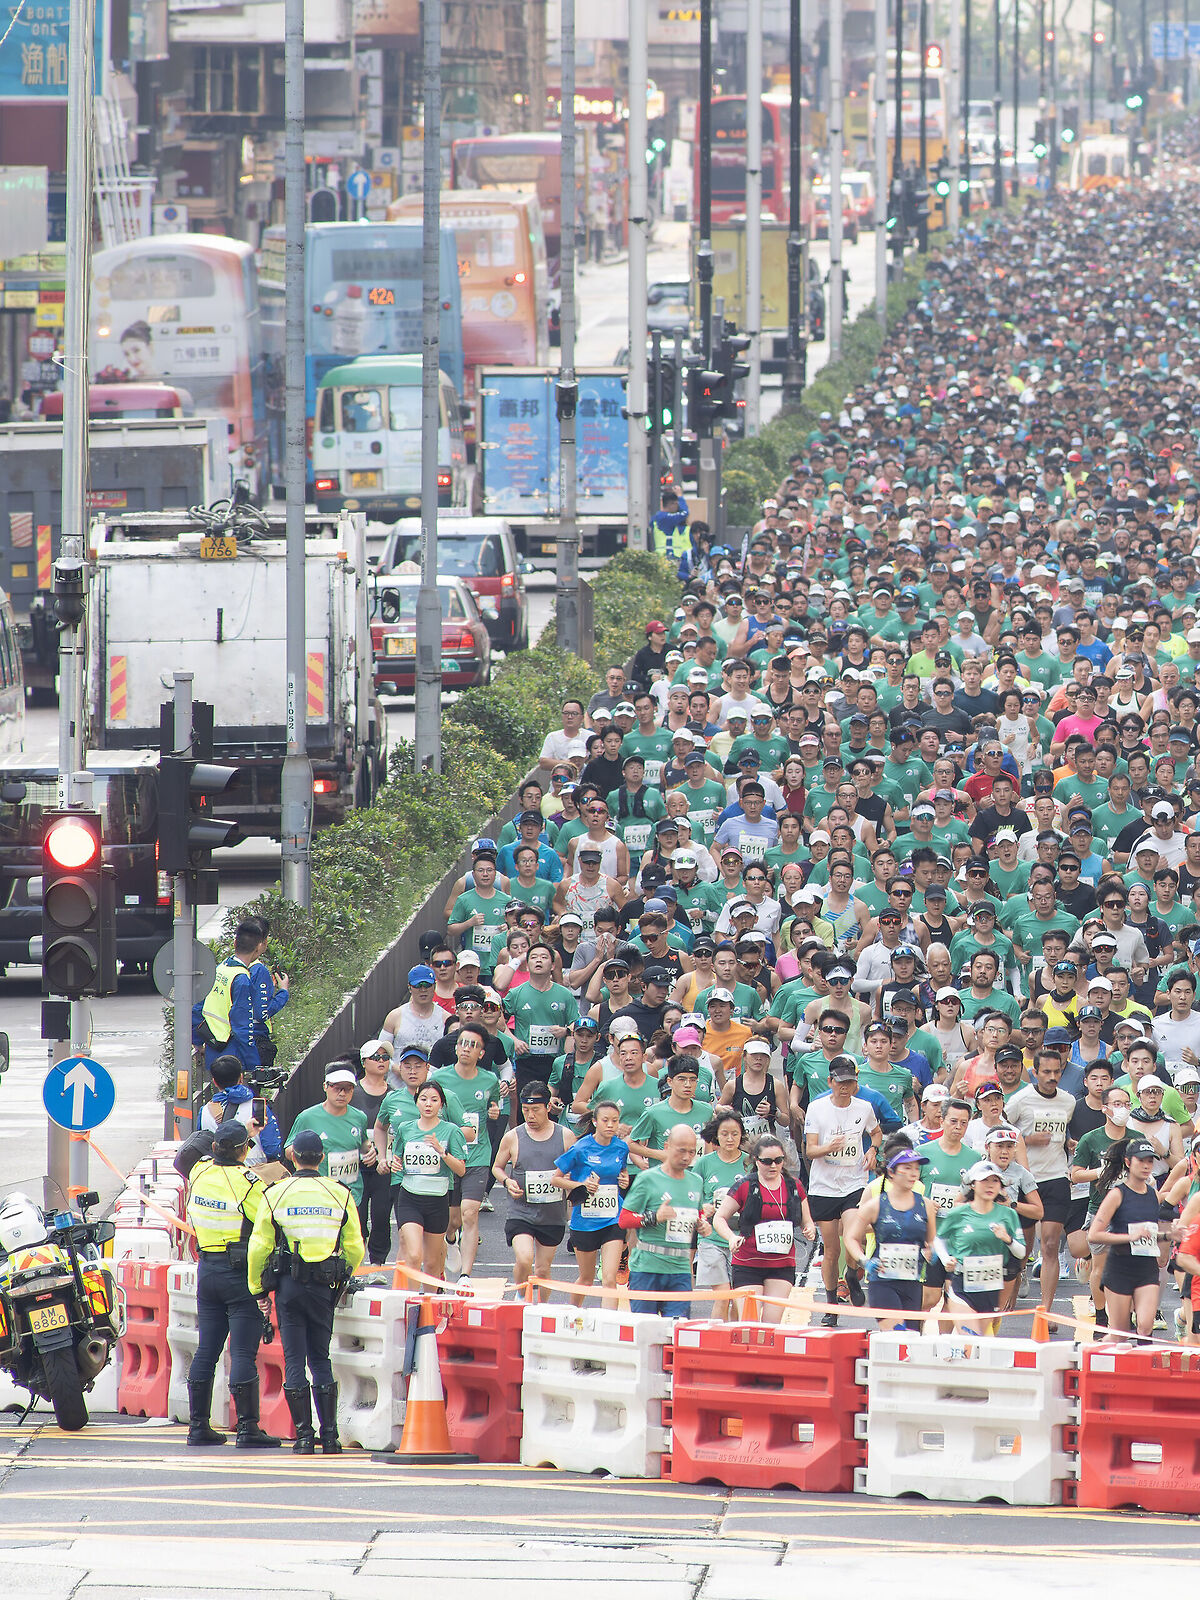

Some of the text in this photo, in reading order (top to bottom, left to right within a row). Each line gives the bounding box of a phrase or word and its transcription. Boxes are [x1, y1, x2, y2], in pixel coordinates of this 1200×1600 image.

[27, 6, 64, 19] BOAT
[21, 42, 68, 85] 漁船
[368, 288, 395, 304] 42A
[211, 537, 227, 548] XA
[205, 547, 233, 557] 1756
[644, 769, 659, 777] 707
[740, 844, 765, 855] E0111
[474, 934, 491, 944] E24
[1035, 1121, 1065, 1133] E2570
[405, 1154, 438, 1166] E2633
[330, 1161, 358, 1177] E7470
[199, 1196, 219, 1209] POLICE
[583, 1197, 616, 1208] E4630
[932, 1196, 954, 1209] E25
[297, 1207, 323, 1215] POLICE
[758, 1233, 792, 1244] E5859
[40, 1307, 56, 1320] AM
[33, 1314, 66, 1330] 8860
